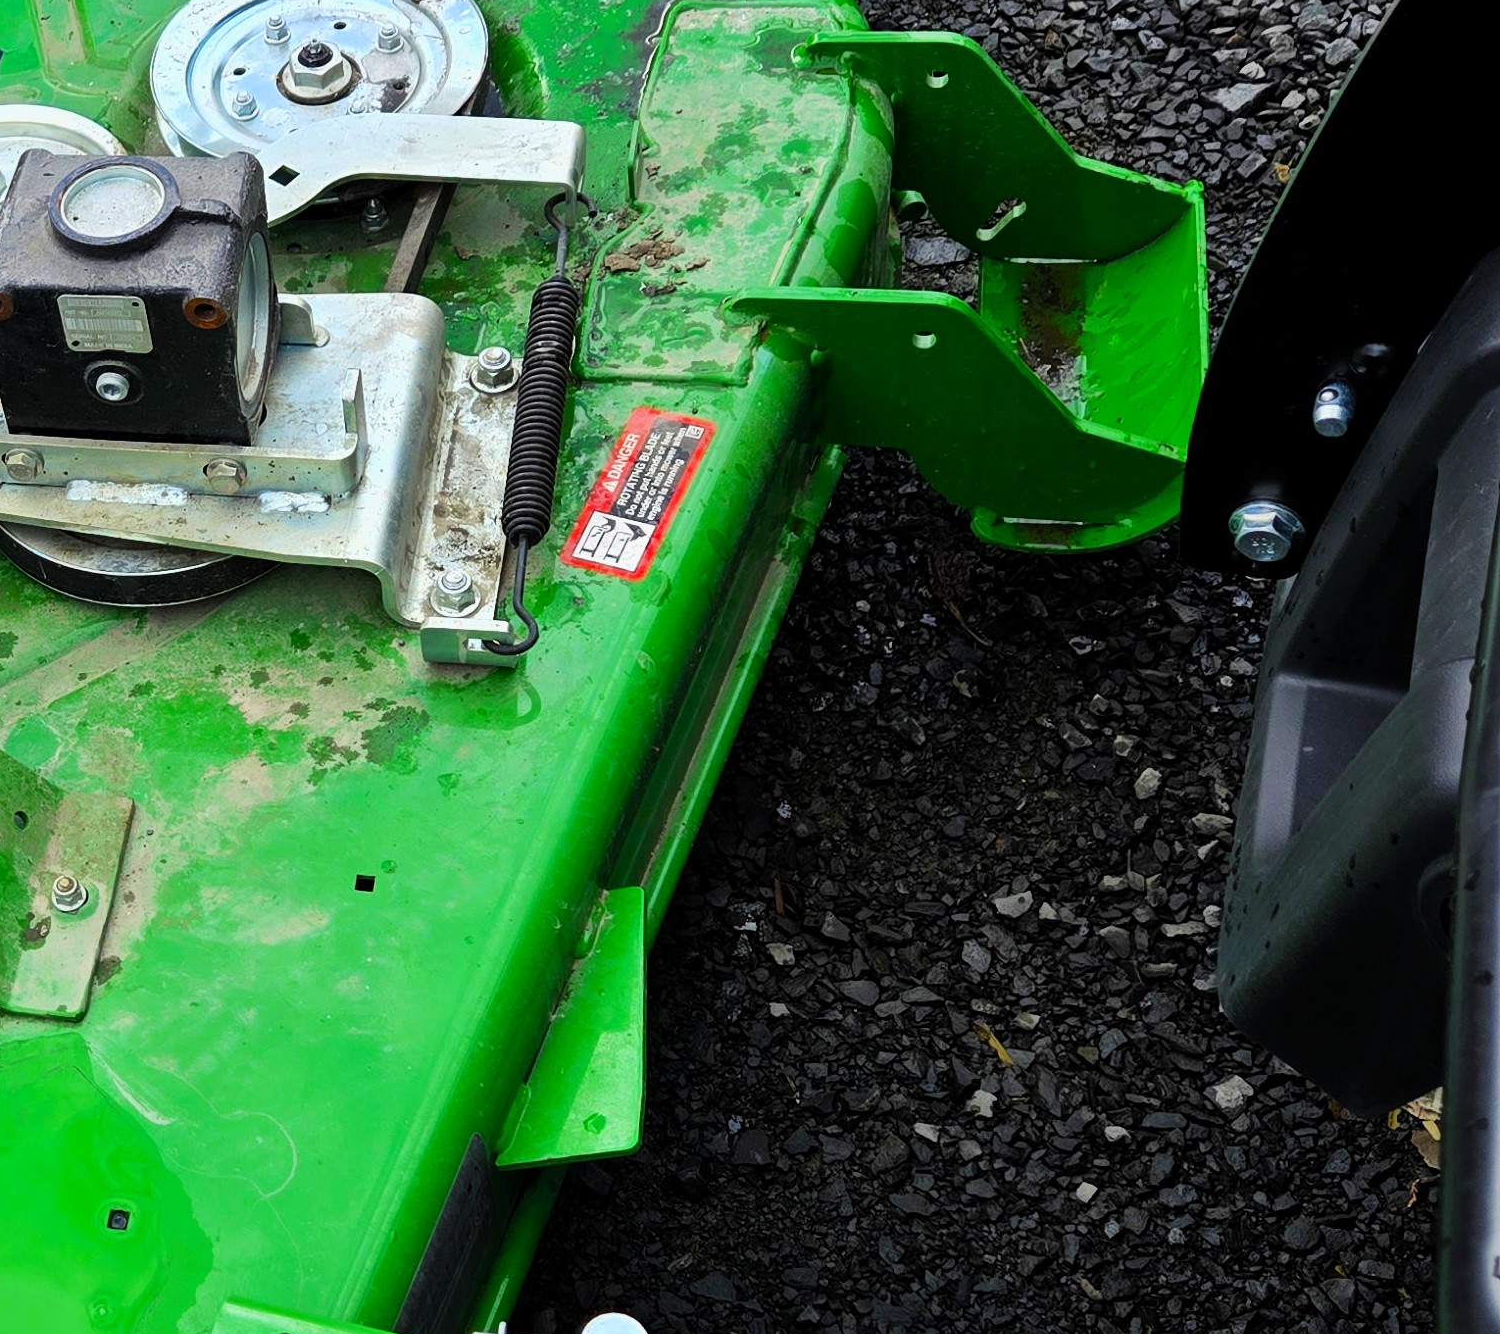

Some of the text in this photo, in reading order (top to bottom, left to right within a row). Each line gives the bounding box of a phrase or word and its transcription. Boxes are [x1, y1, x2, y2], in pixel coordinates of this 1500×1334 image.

[611, 433, 640, 478] DANGER
[617, 431, 662, 506] ROTATING BLADE
[624, 430, 675, 515] Do not put hands or feet
[635, 495, 653, 518] under
[646, 485, 658, 496] or
[659, 446, 678, 472] mower
[671, 426, 688, 447] when
[645, 457, 685, 521] engine is running
